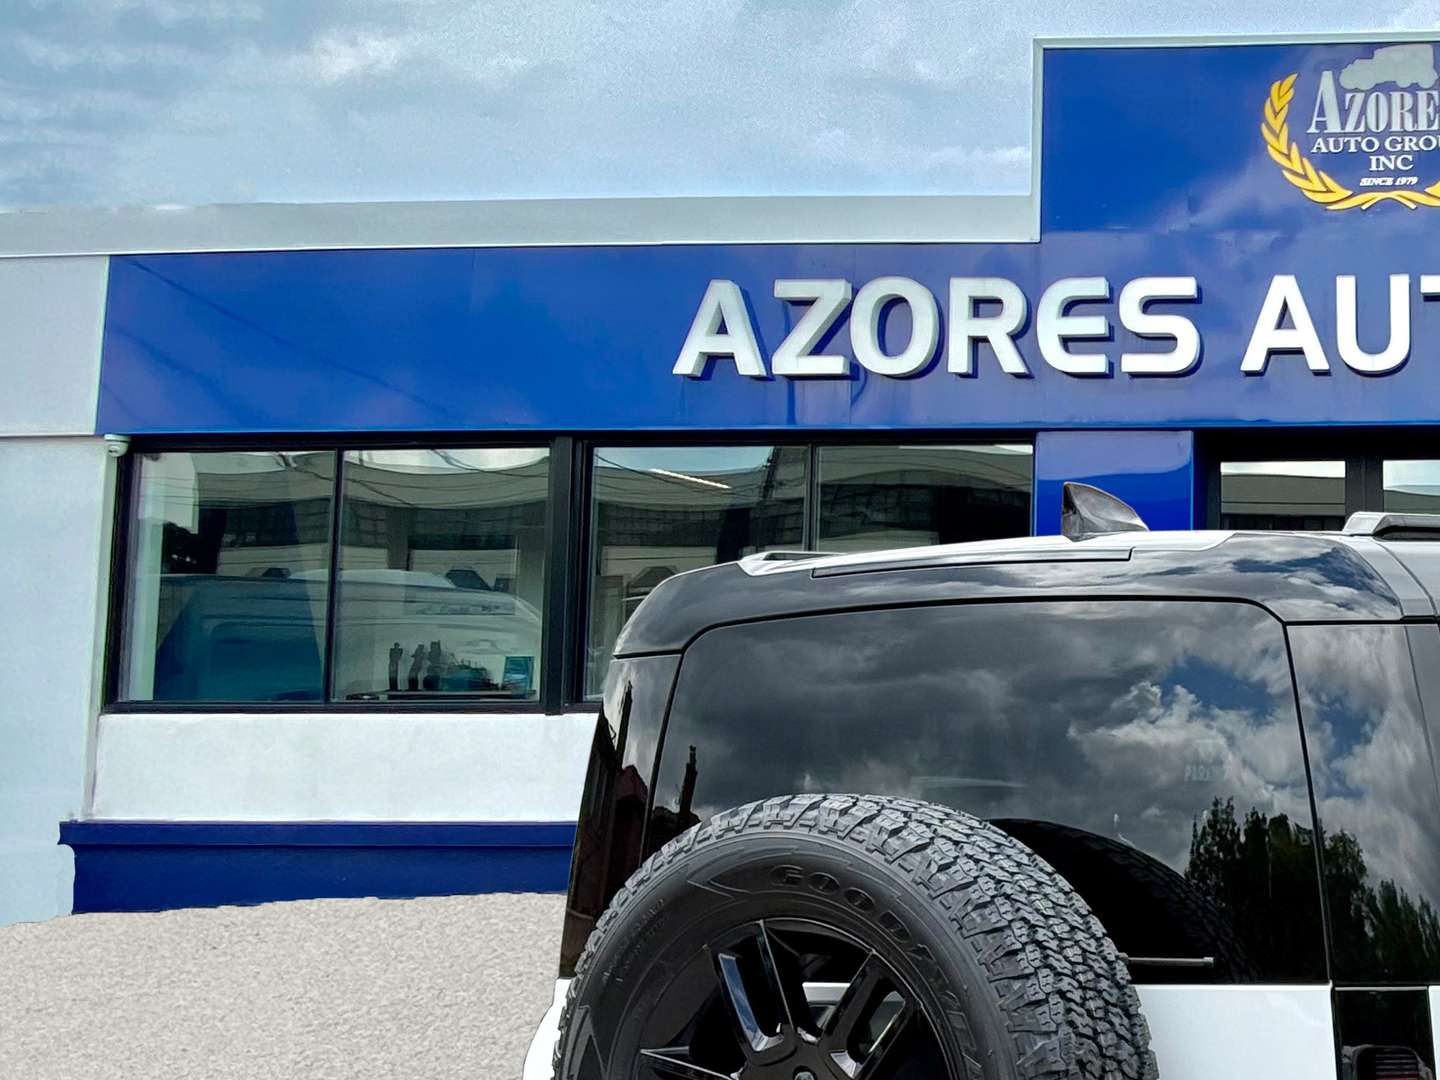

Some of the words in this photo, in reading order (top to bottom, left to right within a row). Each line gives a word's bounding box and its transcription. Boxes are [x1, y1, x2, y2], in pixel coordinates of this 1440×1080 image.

[1311, 137, 1379, 153] AUTO
[1369, 156, 1414, 171] INC
[1360, 177, 1393, 186] SINCE
[1396, 176, 1418, 186] 1979
[672, 276, 1200, 378] AZORES
